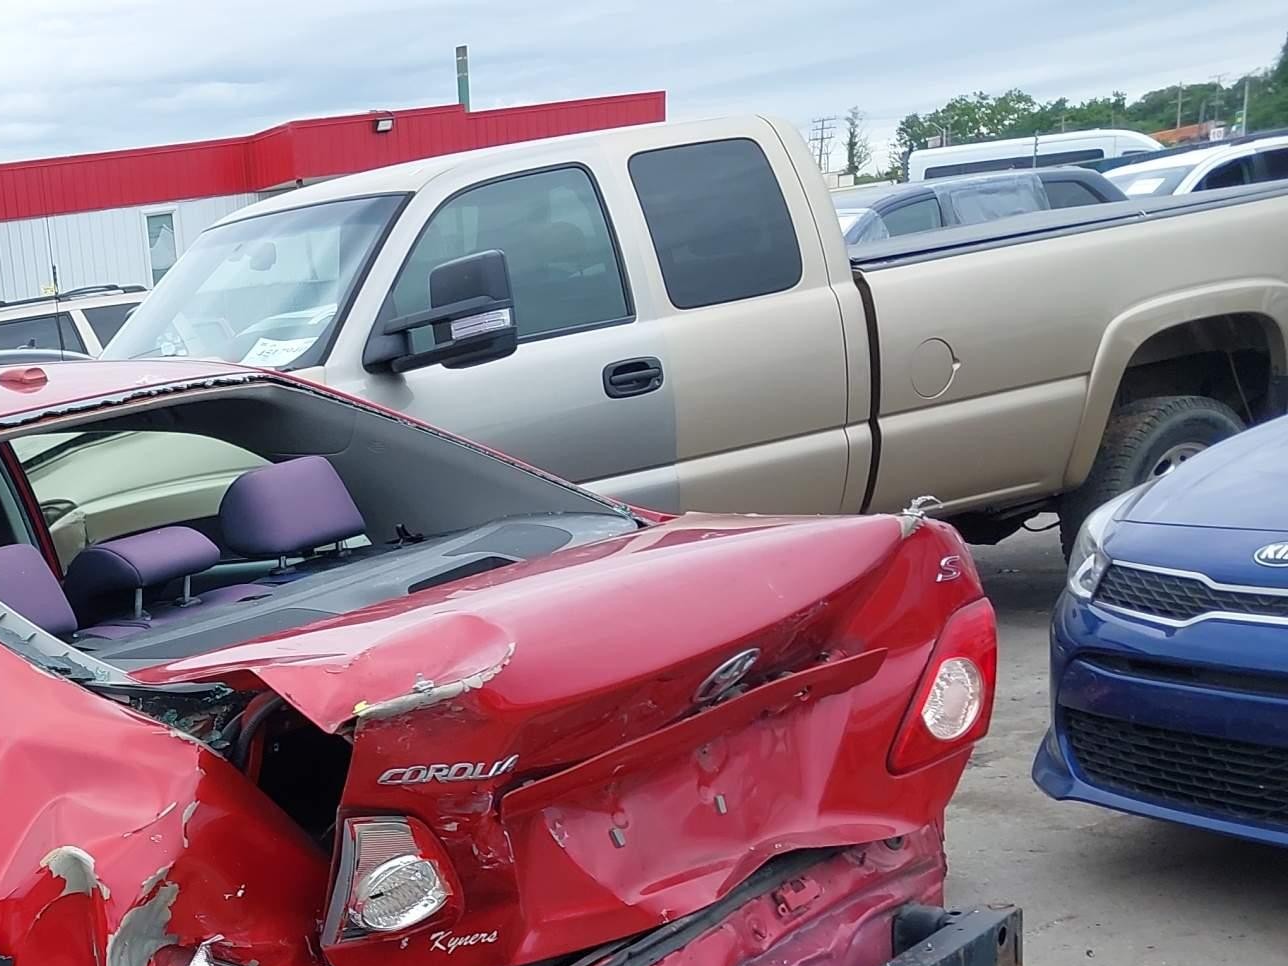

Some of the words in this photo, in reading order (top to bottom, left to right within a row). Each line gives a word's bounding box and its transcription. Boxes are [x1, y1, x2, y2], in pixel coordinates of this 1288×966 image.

[1259, 544, 1288, 560] KI
[936, 555, 961, 582] S
[430, 930, 498, 955] Kyners
